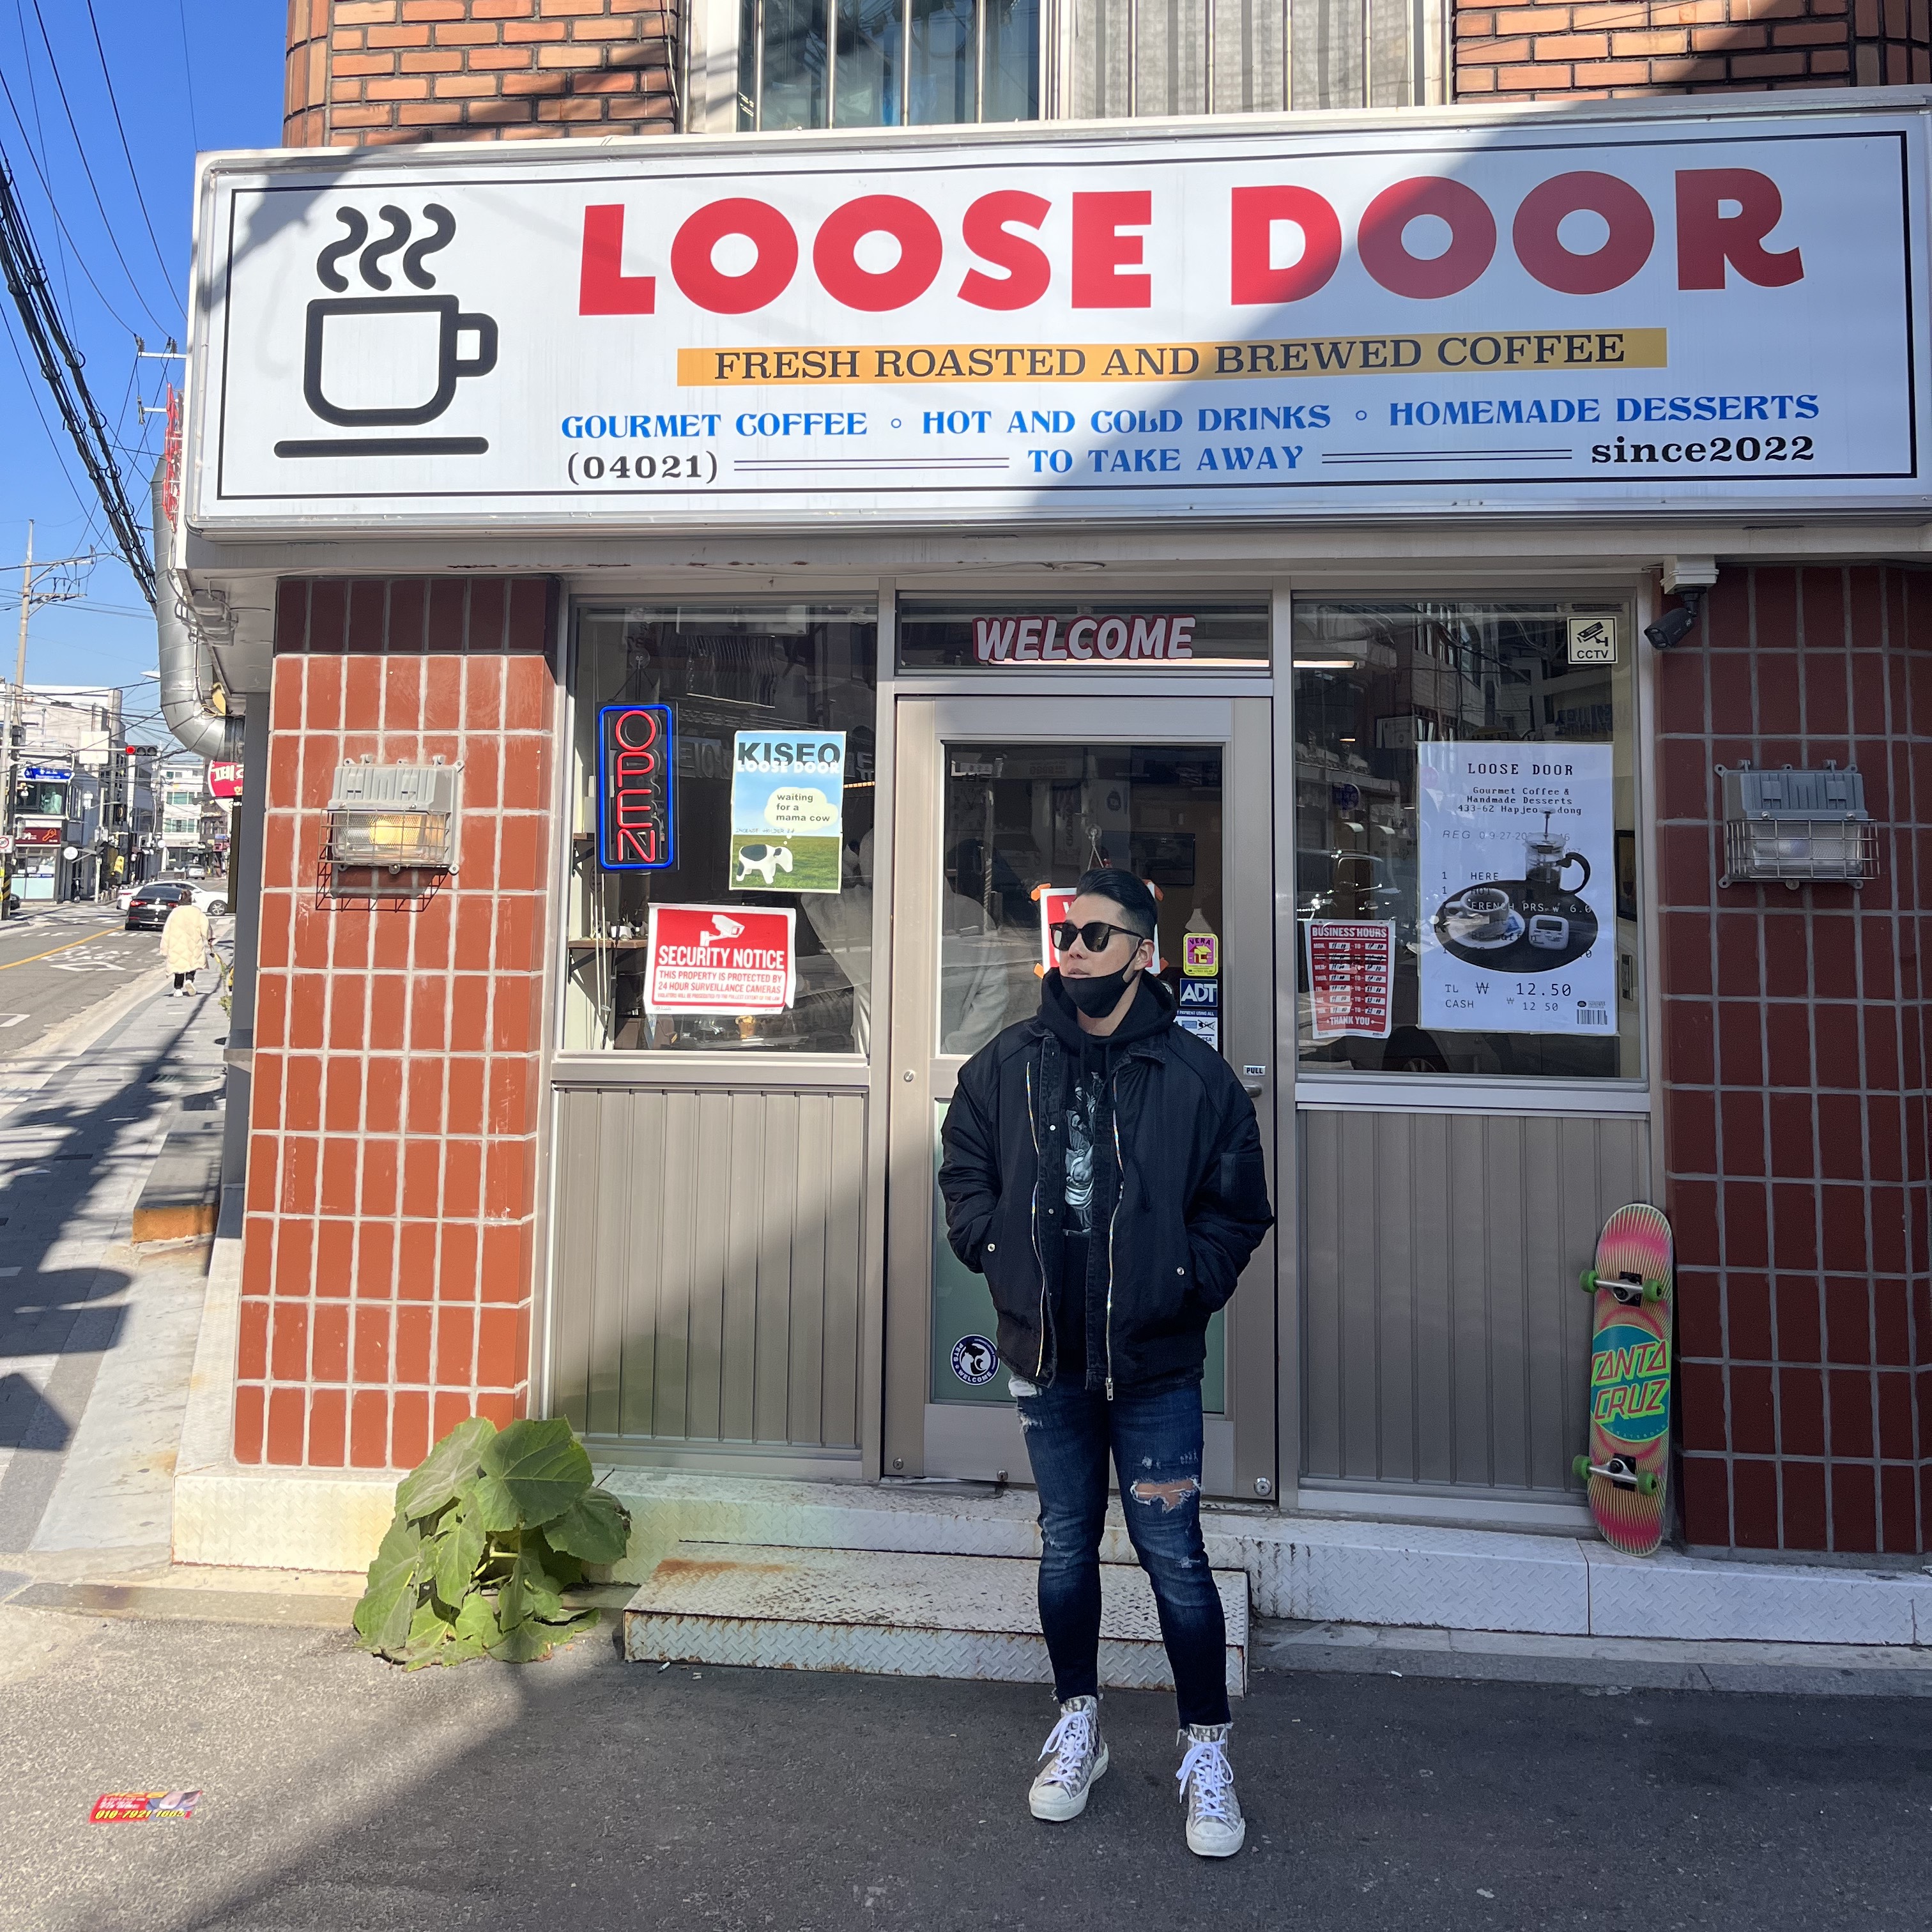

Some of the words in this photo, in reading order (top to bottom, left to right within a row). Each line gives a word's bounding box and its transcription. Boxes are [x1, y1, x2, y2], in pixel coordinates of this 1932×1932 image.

[579, 190, 1152, 316] LOOSE
[1230, 167, 1805, 306] DOOR
[715, 350, 860, 379] FRESH
[875, 348, 1086, 378] ROASTED
[1101, 347, 1199, 376] AND
[1215, 339, 1423, 374] BREWED
[1438, 334, 1626, 367] COFFEE
[562, 414, 721, 438] GOURMET
[735, 412, 868, 436] COFFEE
[923, 410, 992, 434] HOT
[1007, 410, 1075, 433] AND
[1091, 409, 1183, 433] COLD
[1197, 404, 1331, 431] DRINKS
[1390, 397, 1600, 426] HOMEMADE
[1616, 394, 1819, 422] DESSERTS
[1591, 436, 1815, 463] since2022
[1028, 449, 1073, 473] TO
[1087, 448, 1180, 473] TAKE
[1196, 445, 1303, 471] AWAY
[567, 450, 718, 485] (04021)
[972, 615, 1196, 661] WELCOME
[1577, 650, 1608, 659] CCTV
[737, 760, 788, 772] LOOSE
[793, 762, 840, 774] DOOR
[1468, 763, 1519, 775] LOOSE
[1532, 764, 1574, 776] DOOR
[615, 710, 656, 862] OPEN
[777, 793, 813, 802] waiting
[1523, 797, 1572, 805] Desserts
[1443, 831, 1471, 839] REG
[1471, 872, 1499, 880] HERE
[1442, 886, 1447, 894] 1
[1471, 901, 1515, 910] FRENCH
[1523, 903, 1544, 912] PRS
[1312, 928, 1356, 937] BUSINESS
[1357, 928, 1387, 937] HOURS
[659, 946, 730, 967] SECURITY
[733, 948, 785, 969] NOTICE
[659, 970, 676, 979] THIS
[678, 971, 717, 981] PROPERTY
[719, 972, 726, 981] IS
[727, 973, 770, 983] PROTECTED
[772, 974, 782, 983] BY
[658, 982, 668, 990] 24
[670, 982, 689, 991] HOUR
[691, 983, 744, 992] SURVEILLANCE
[746, 985, 781, 993] CAMERAS
[1181, 983, 1217, 1002] ADT
[1445, 985, 1459, 993] TL
[1516, 983, 1571, 997] 12.50
[1445, 1000, 1474, 1009] CASH
[1330, 1016, 1353, 1025] THANK
[1355, 1016, 1370, 1025] YOU
[958, 1369, 992, 1383] WELCOME
[1593, 1378, 1669, 1424] CRUZ
